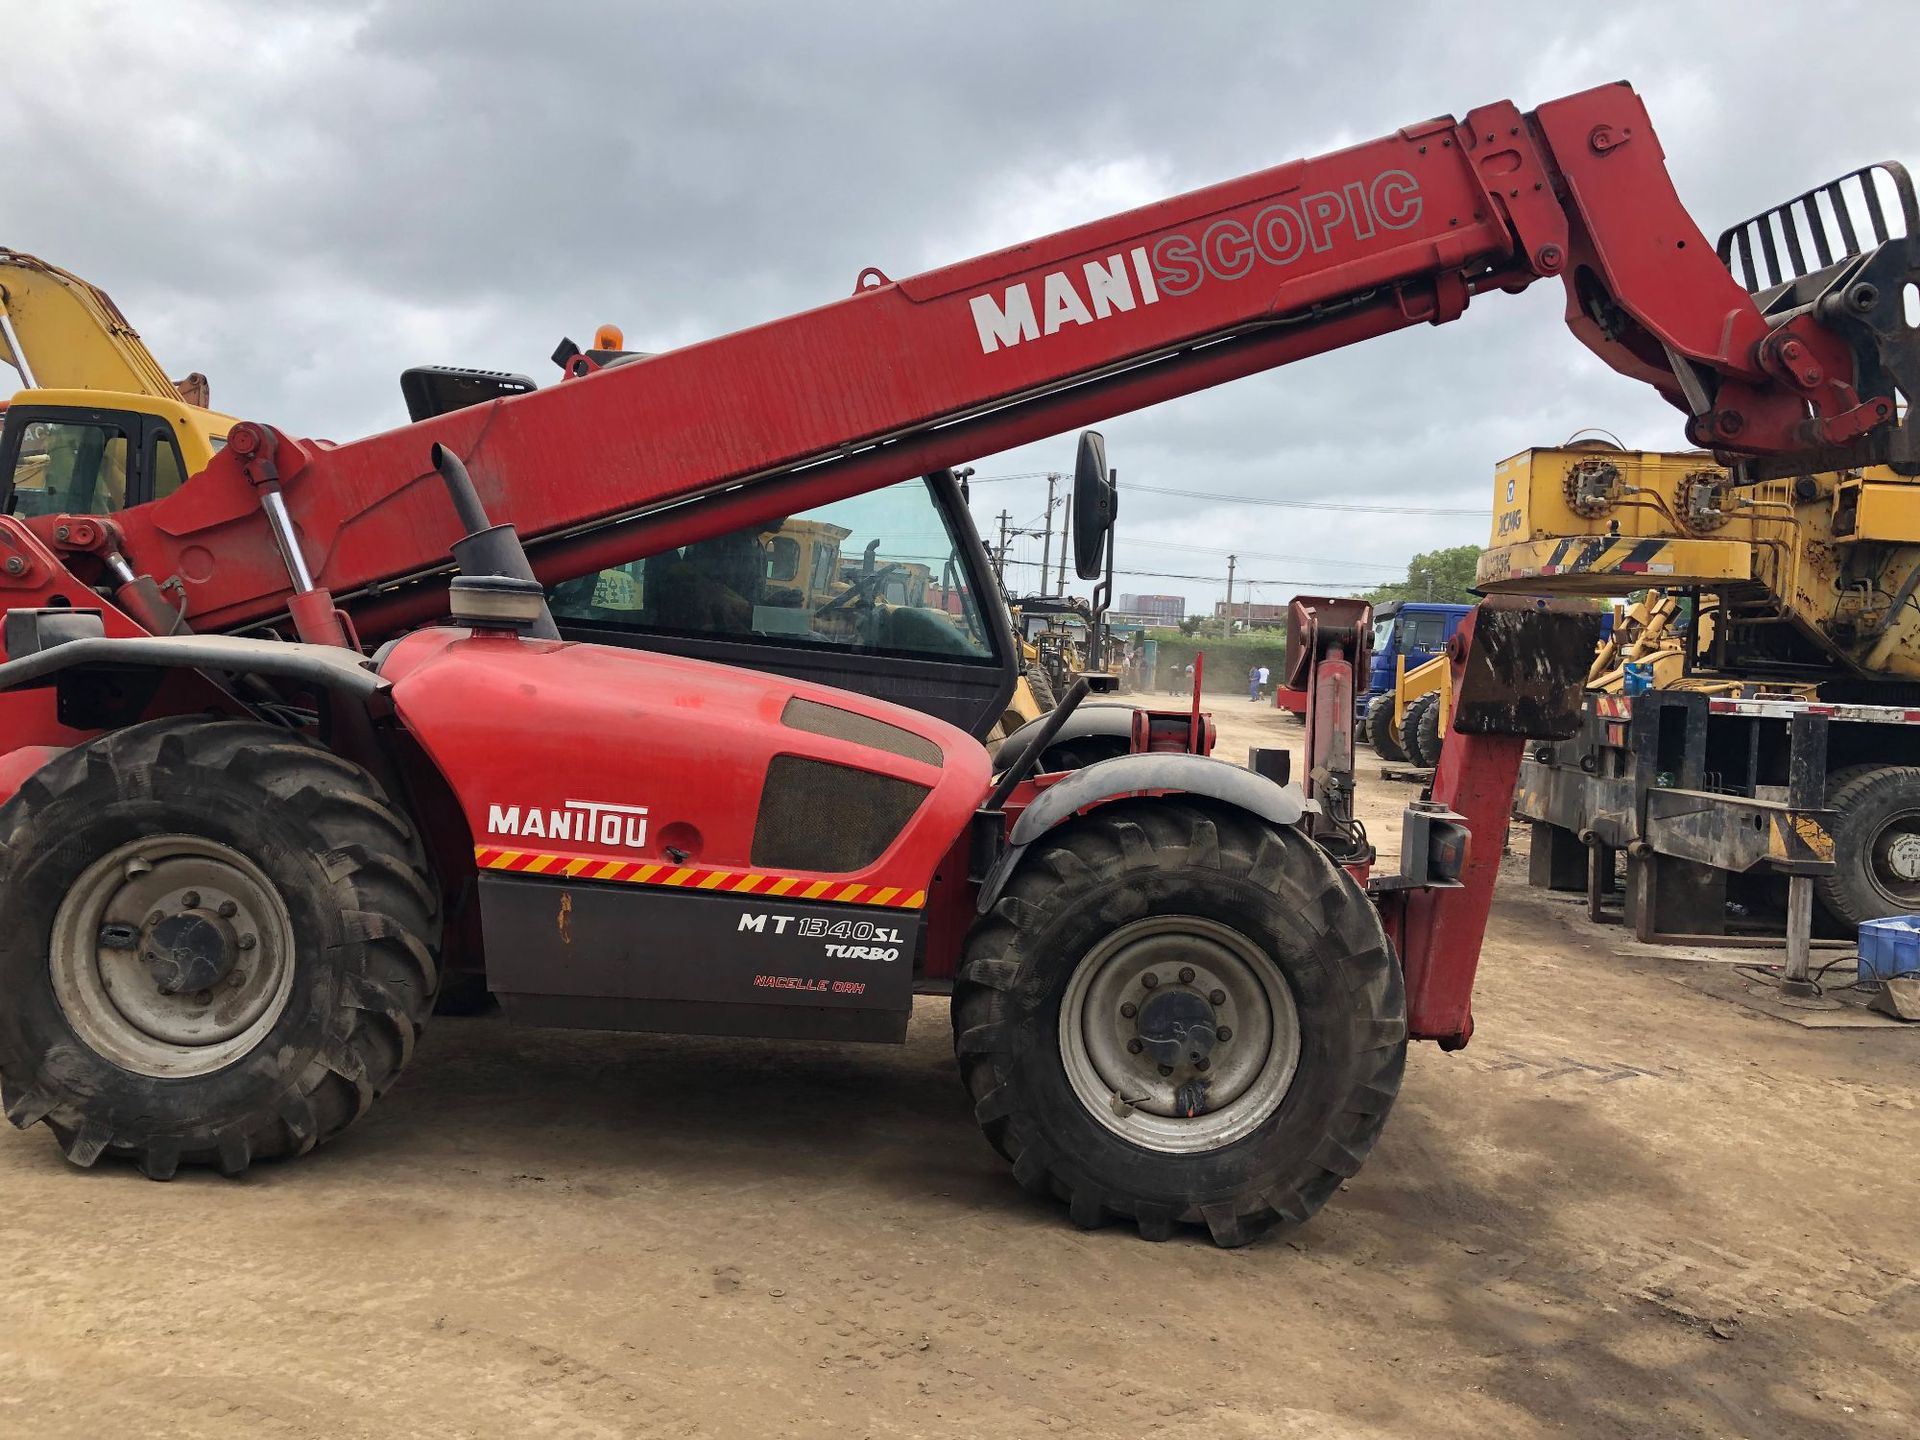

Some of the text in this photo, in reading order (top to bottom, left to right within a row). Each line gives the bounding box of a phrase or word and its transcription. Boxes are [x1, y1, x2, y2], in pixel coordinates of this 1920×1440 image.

[968, 169, 1424, 355] MANISCOPIC
[487, 800, 649, 848] MANITOU
[737, 913, 796, 935] MT
[824, 944, 900, 962] TURBO
[753, 974, 830, 992] NACELLE
